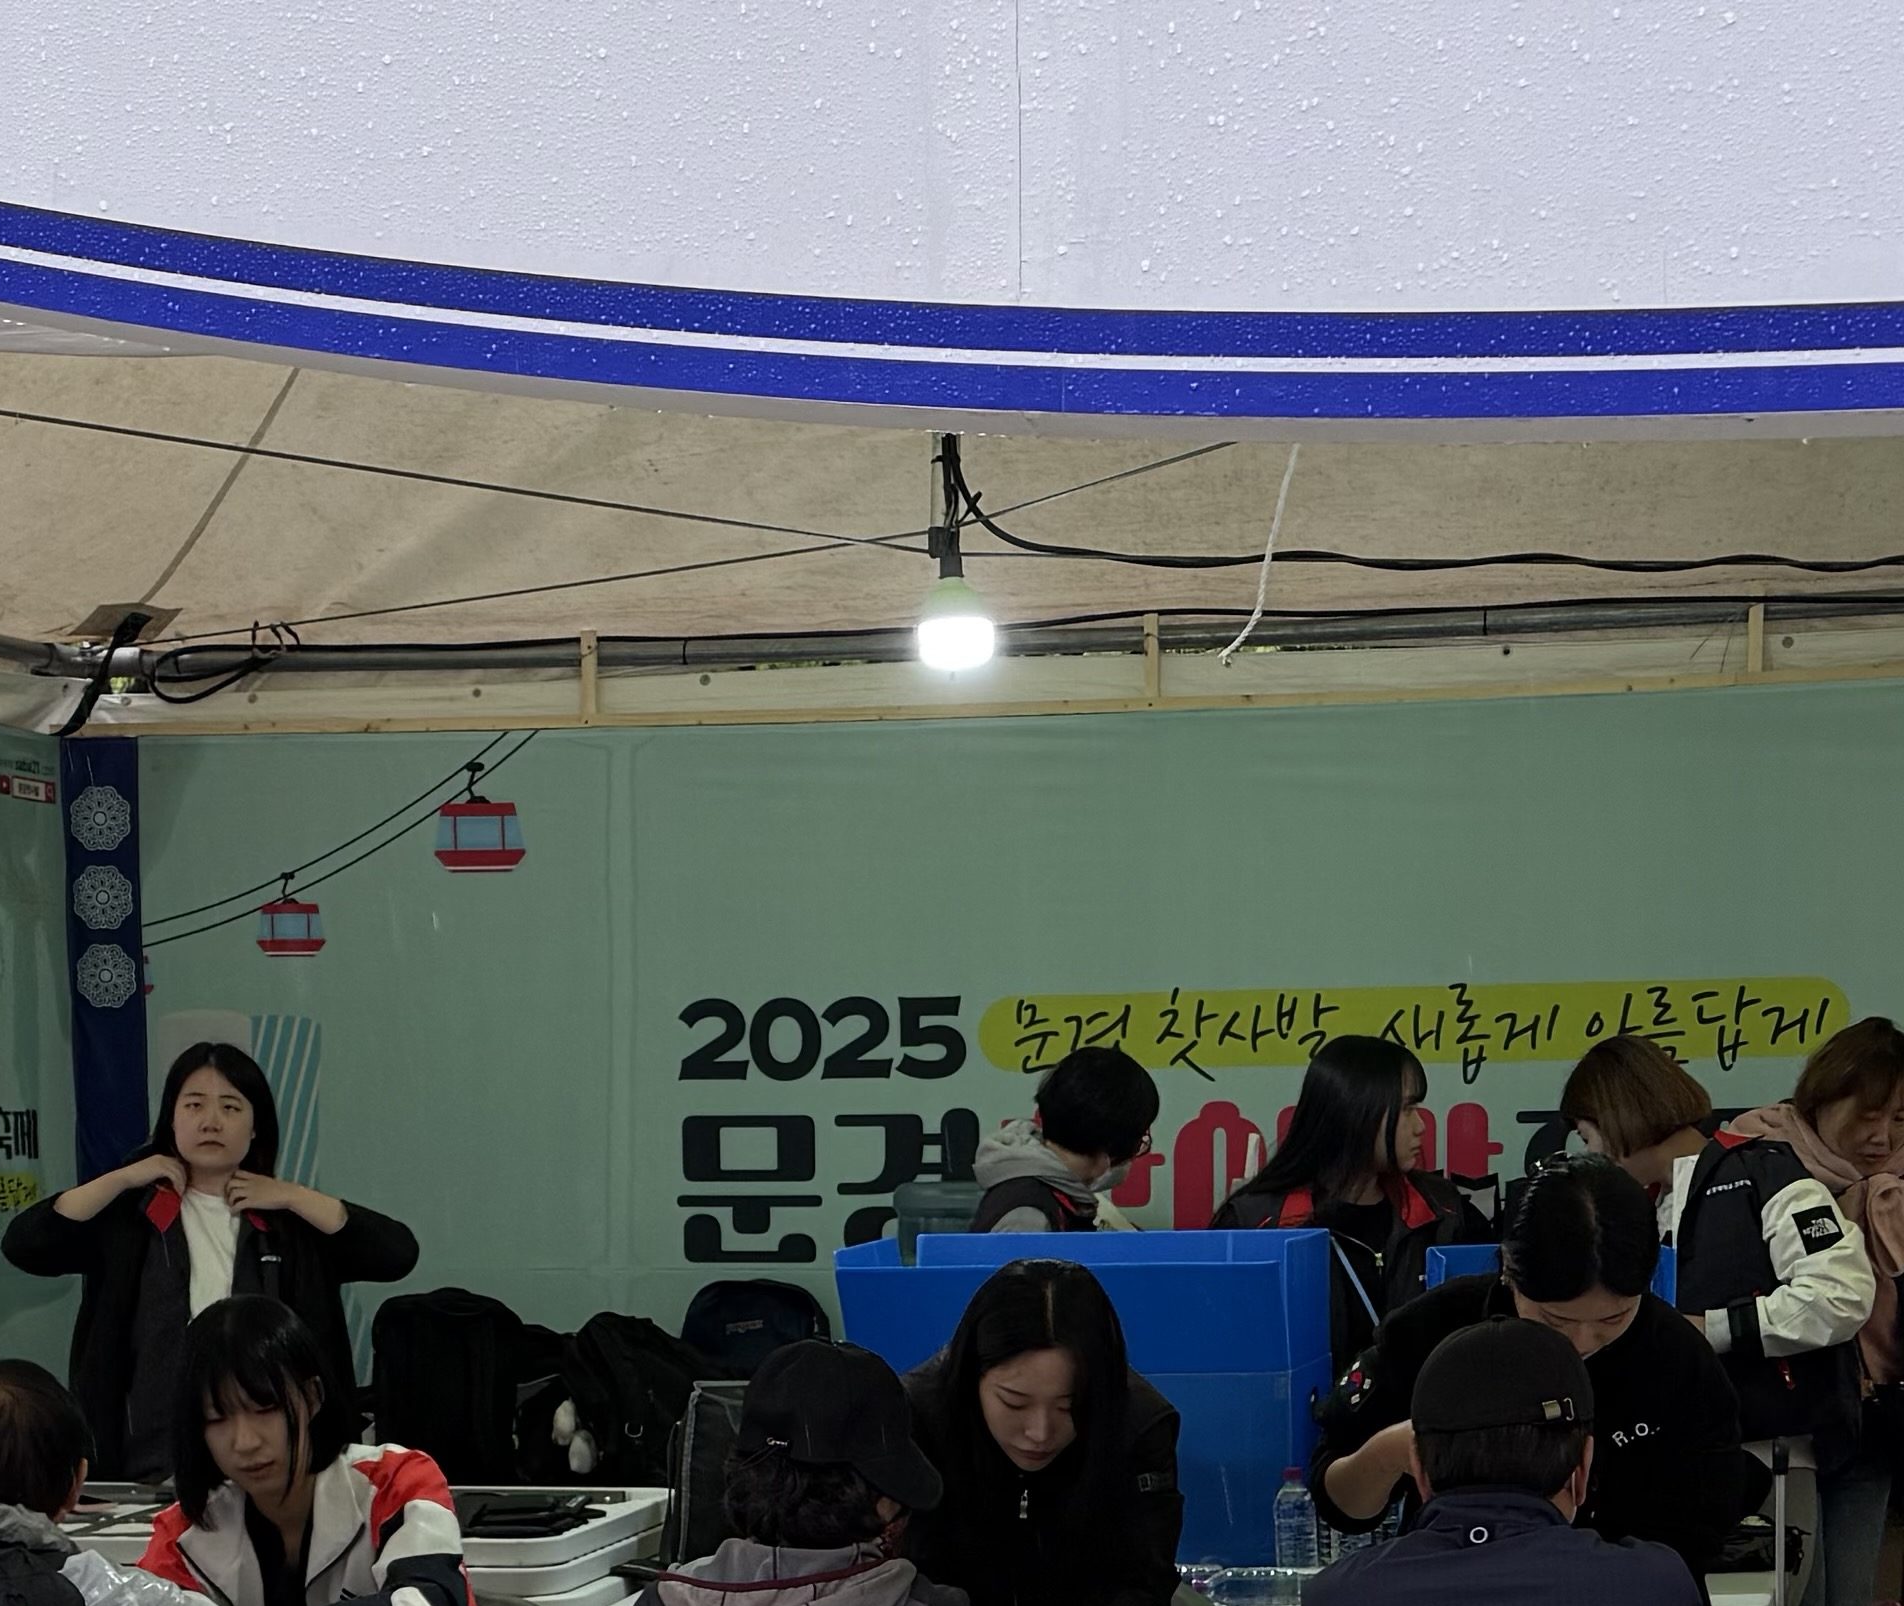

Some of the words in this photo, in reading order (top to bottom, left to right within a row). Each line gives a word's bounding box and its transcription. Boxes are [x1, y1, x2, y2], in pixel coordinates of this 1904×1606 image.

[677, 995, 968, 1082] 2025
[1014, 997, 1130, 1074] 문경
[1379, 982, 1561, 1086] 새롭게
[1585, 984, 1831, 1073] 아름답게
